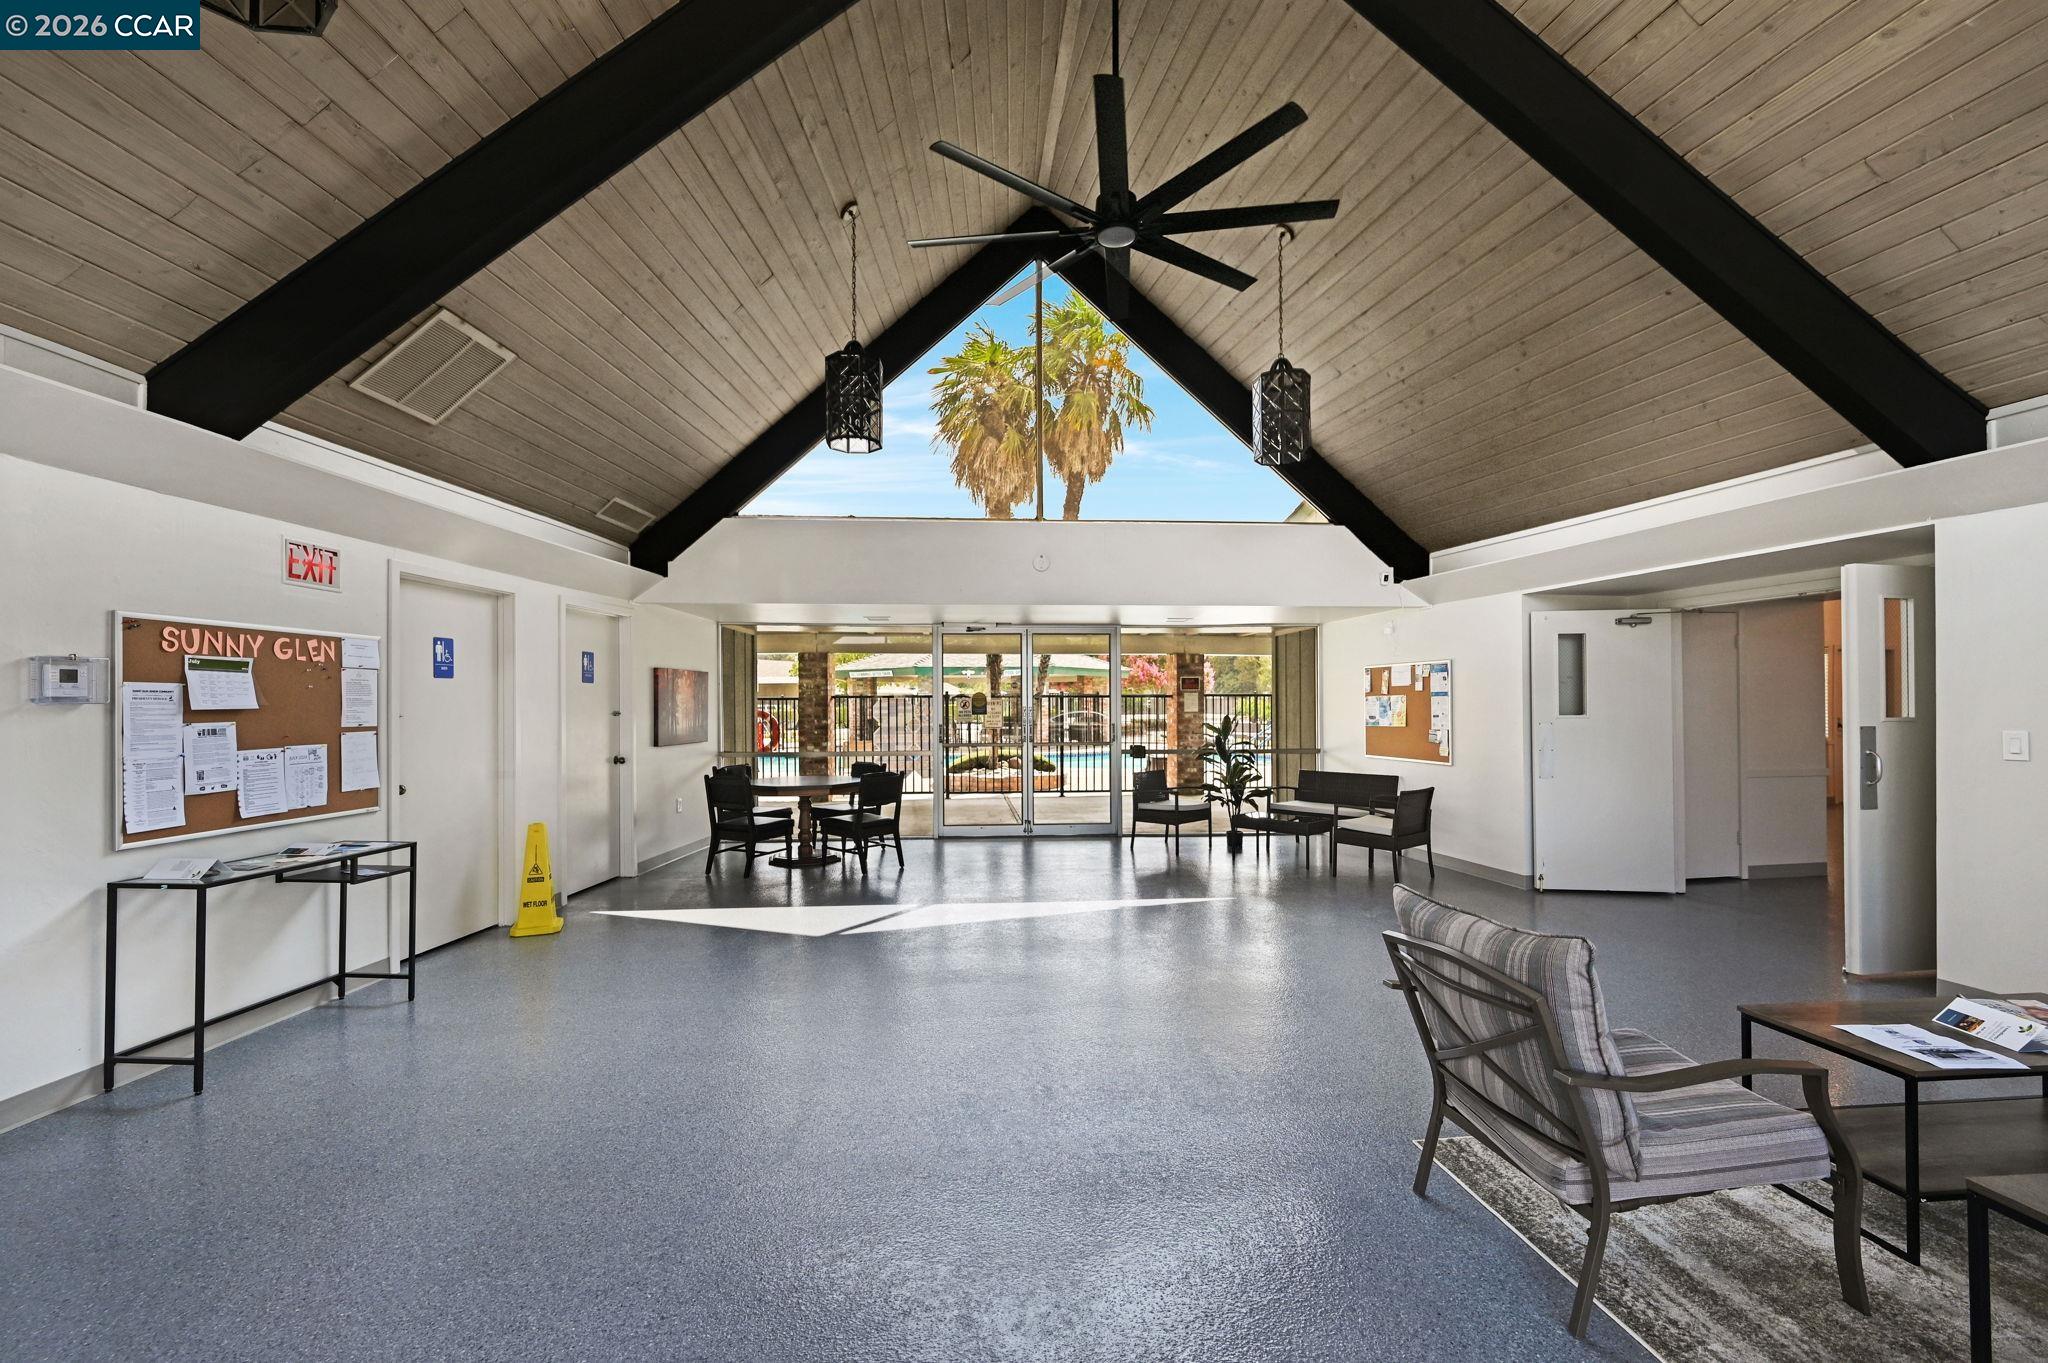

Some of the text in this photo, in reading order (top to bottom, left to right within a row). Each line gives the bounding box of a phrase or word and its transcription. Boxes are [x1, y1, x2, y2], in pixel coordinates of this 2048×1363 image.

[288, 542, 338, 585] EXIT
[161, 626, 265, 658] SUNNY
[273, 637, 335, 662] GLEN
[187, 657, 201, 666] July
